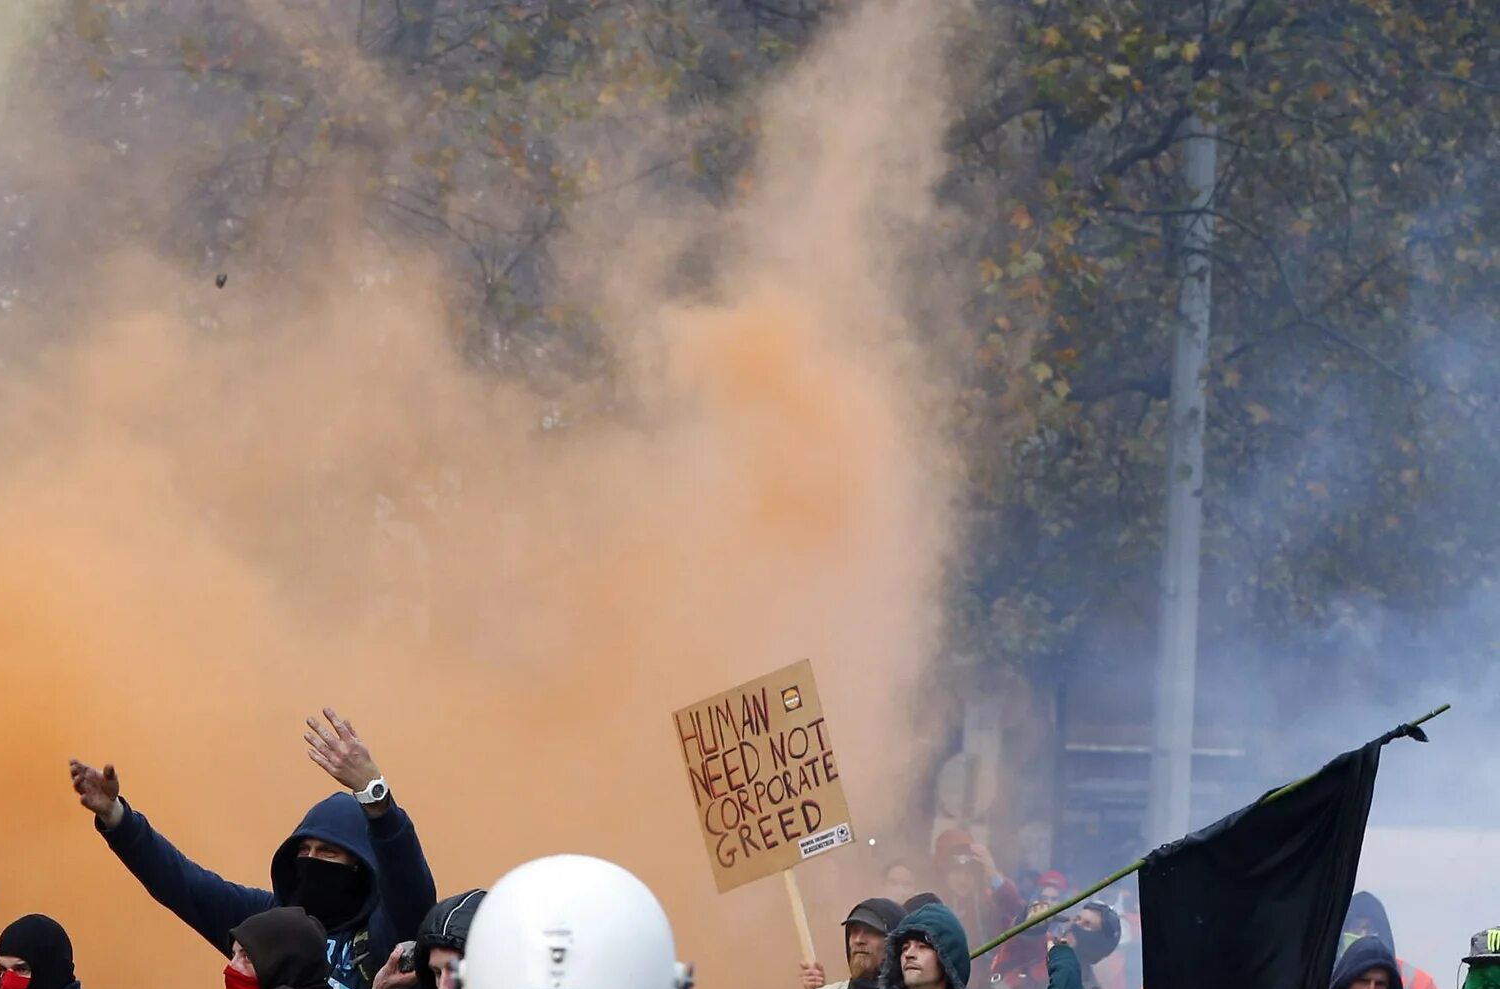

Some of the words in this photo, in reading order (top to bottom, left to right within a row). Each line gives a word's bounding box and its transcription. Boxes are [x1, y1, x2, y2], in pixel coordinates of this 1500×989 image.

[675, 687, 769, 764] HUMAN
[688, 741, 760, 807] NEED
[769, 717, 826, 770] NOT
[705, 751, 839, 836] CORPORATE
[716, 799, 822, 868] GREED
